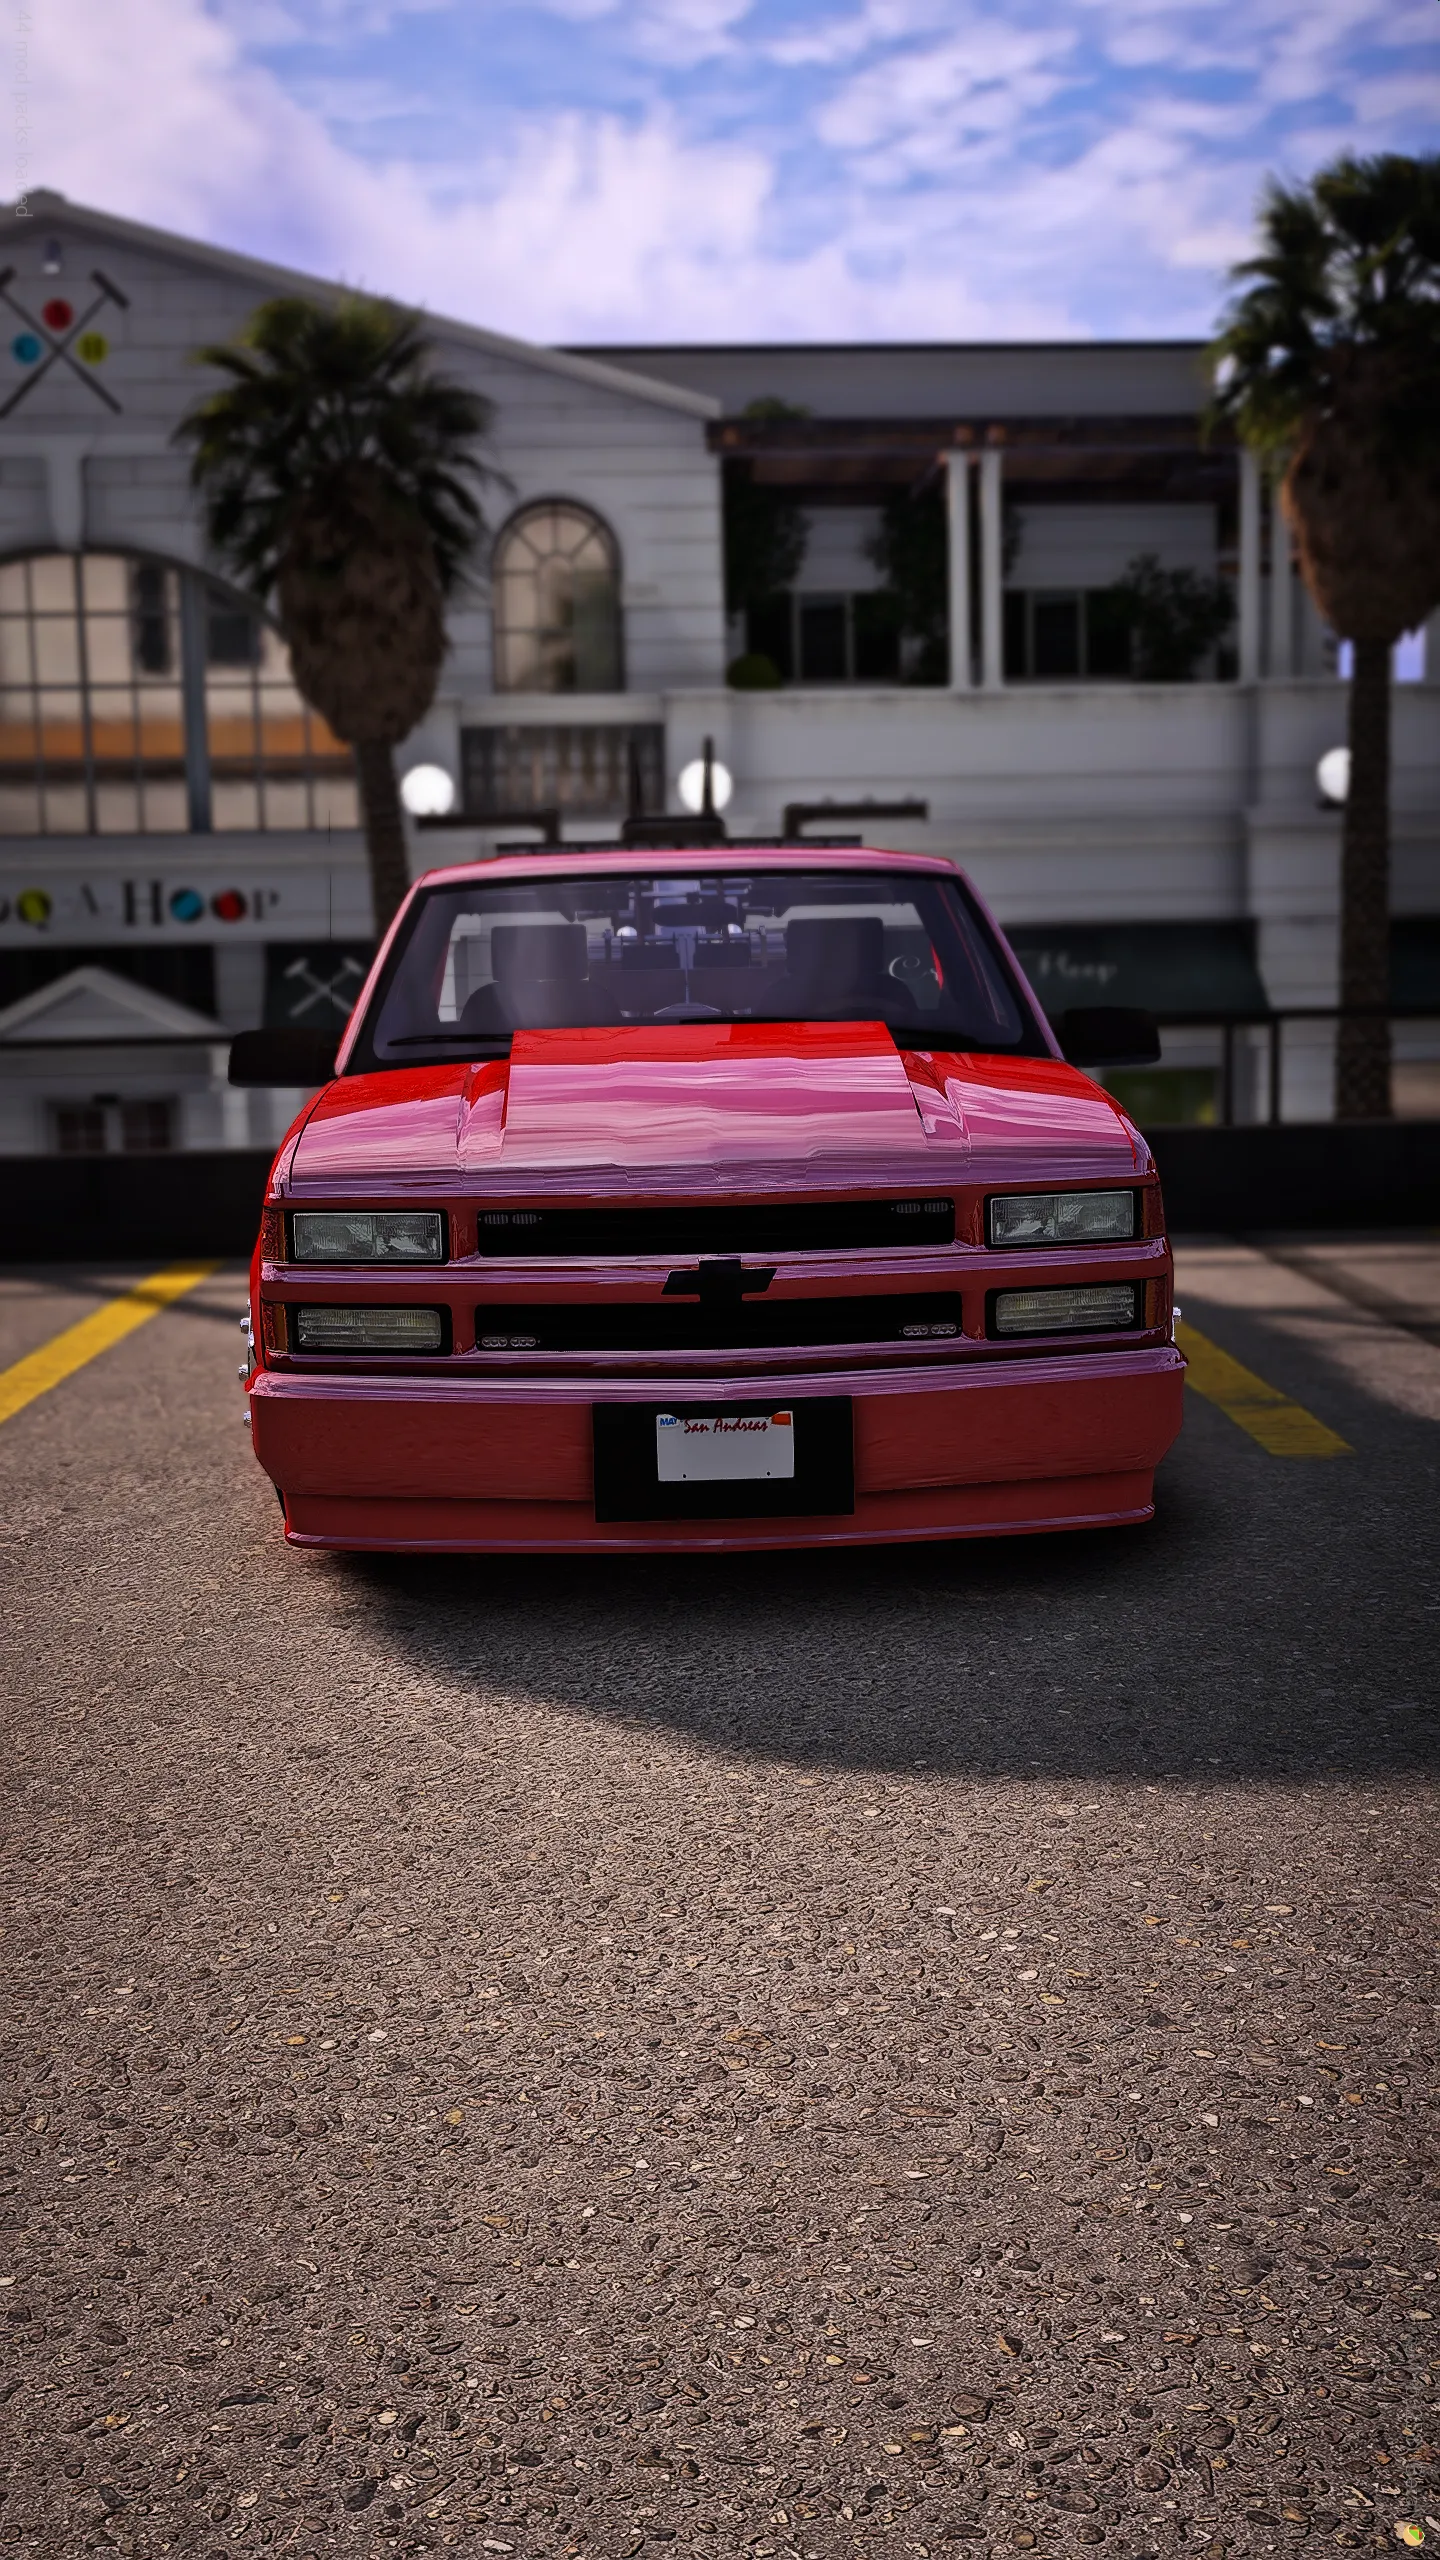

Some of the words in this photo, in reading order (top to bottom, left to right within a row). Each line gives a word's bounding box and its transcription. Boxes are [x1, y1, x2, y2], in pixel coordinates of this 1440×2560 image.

[660, 1417, 678, 1427] MAY
[683, 1418, 710, 1434] San
[713, 1417, 768, 1433] Andreas
